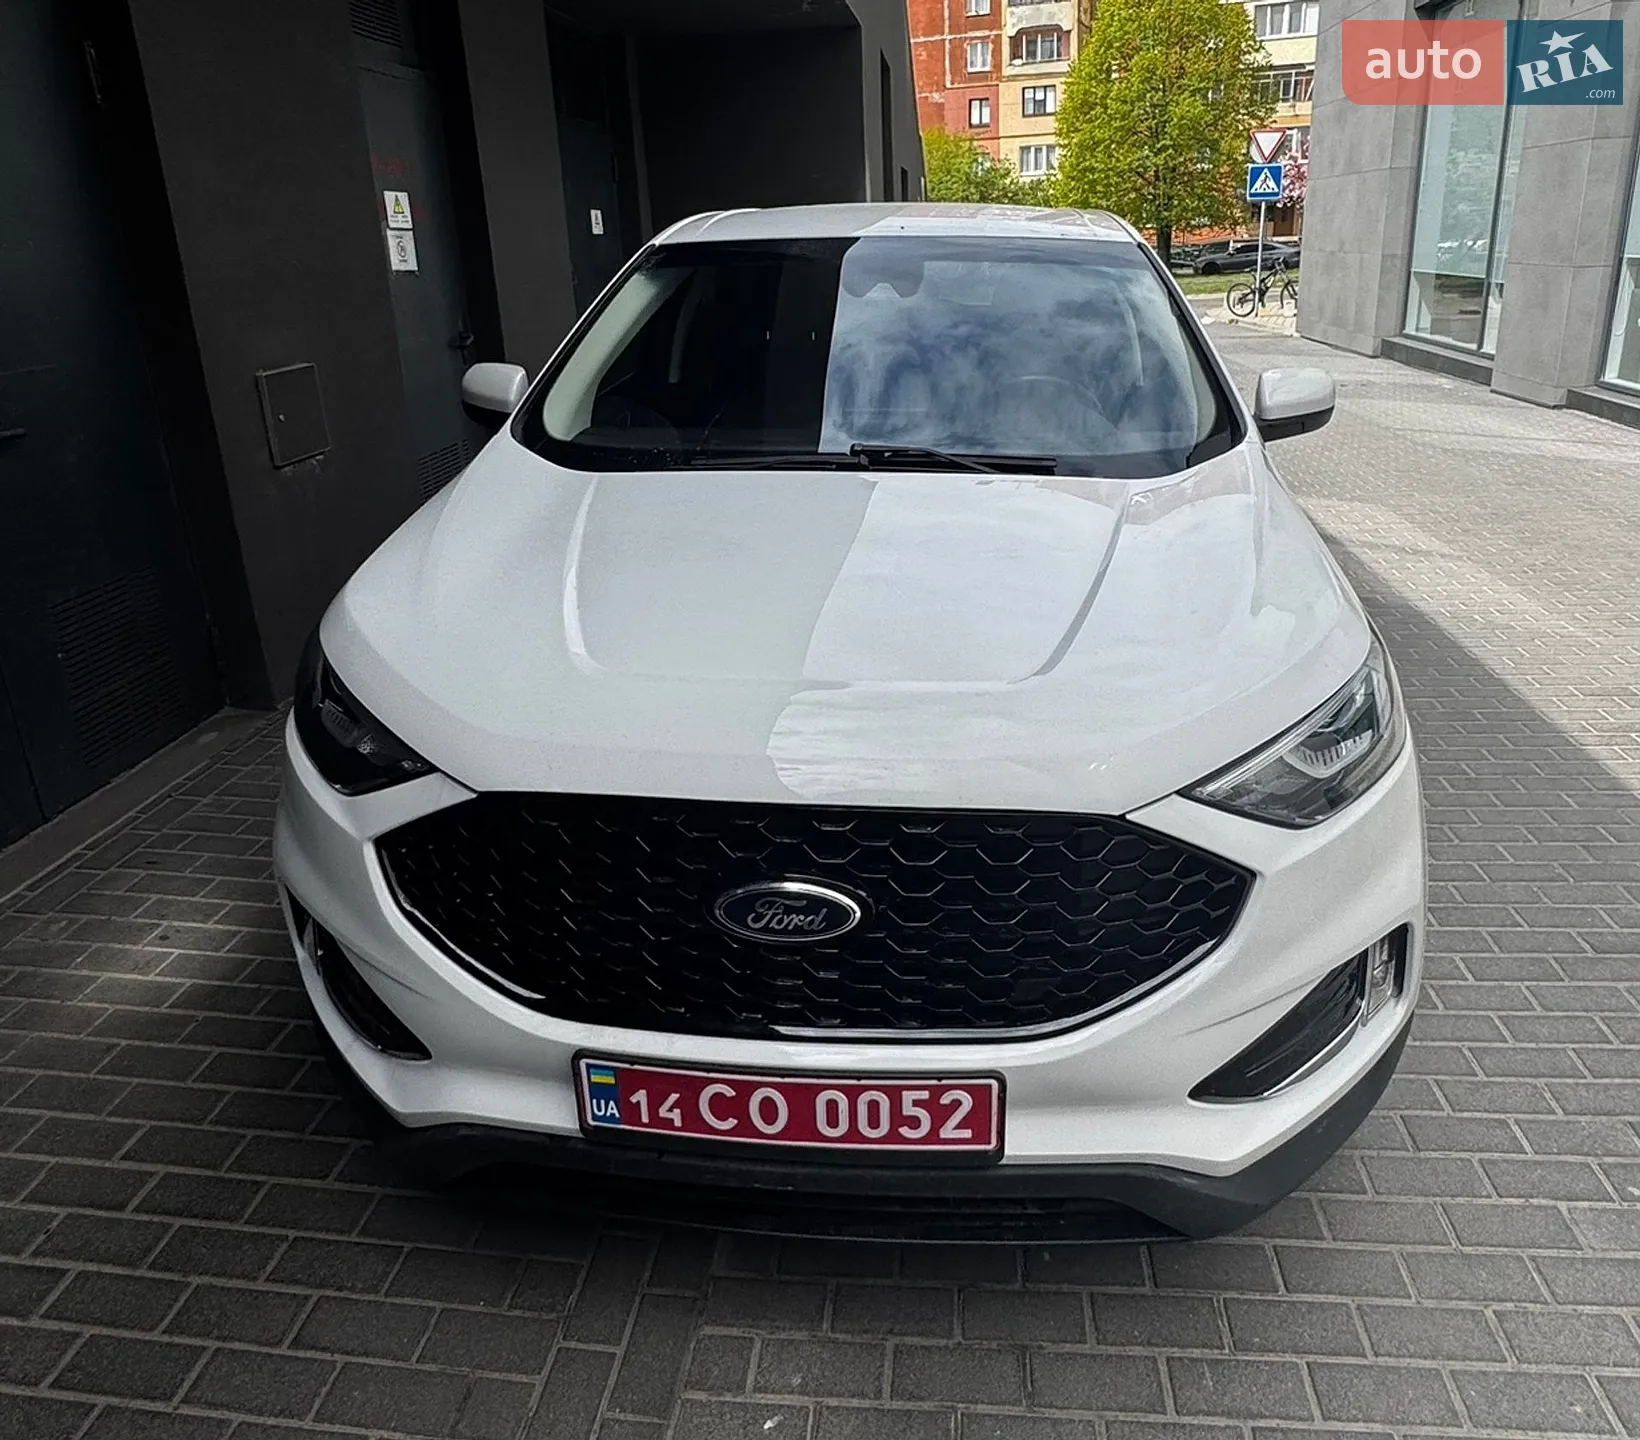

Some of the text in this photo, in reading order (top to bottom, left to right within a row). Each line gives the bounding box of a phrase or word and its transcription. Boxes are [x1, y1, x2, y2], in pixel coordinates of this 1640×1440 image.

[747, 897, 828, 930] Ford
[592, 1099, 620, 1118] UA
[629, 1084, 973, 1139] 14 CO 0052
